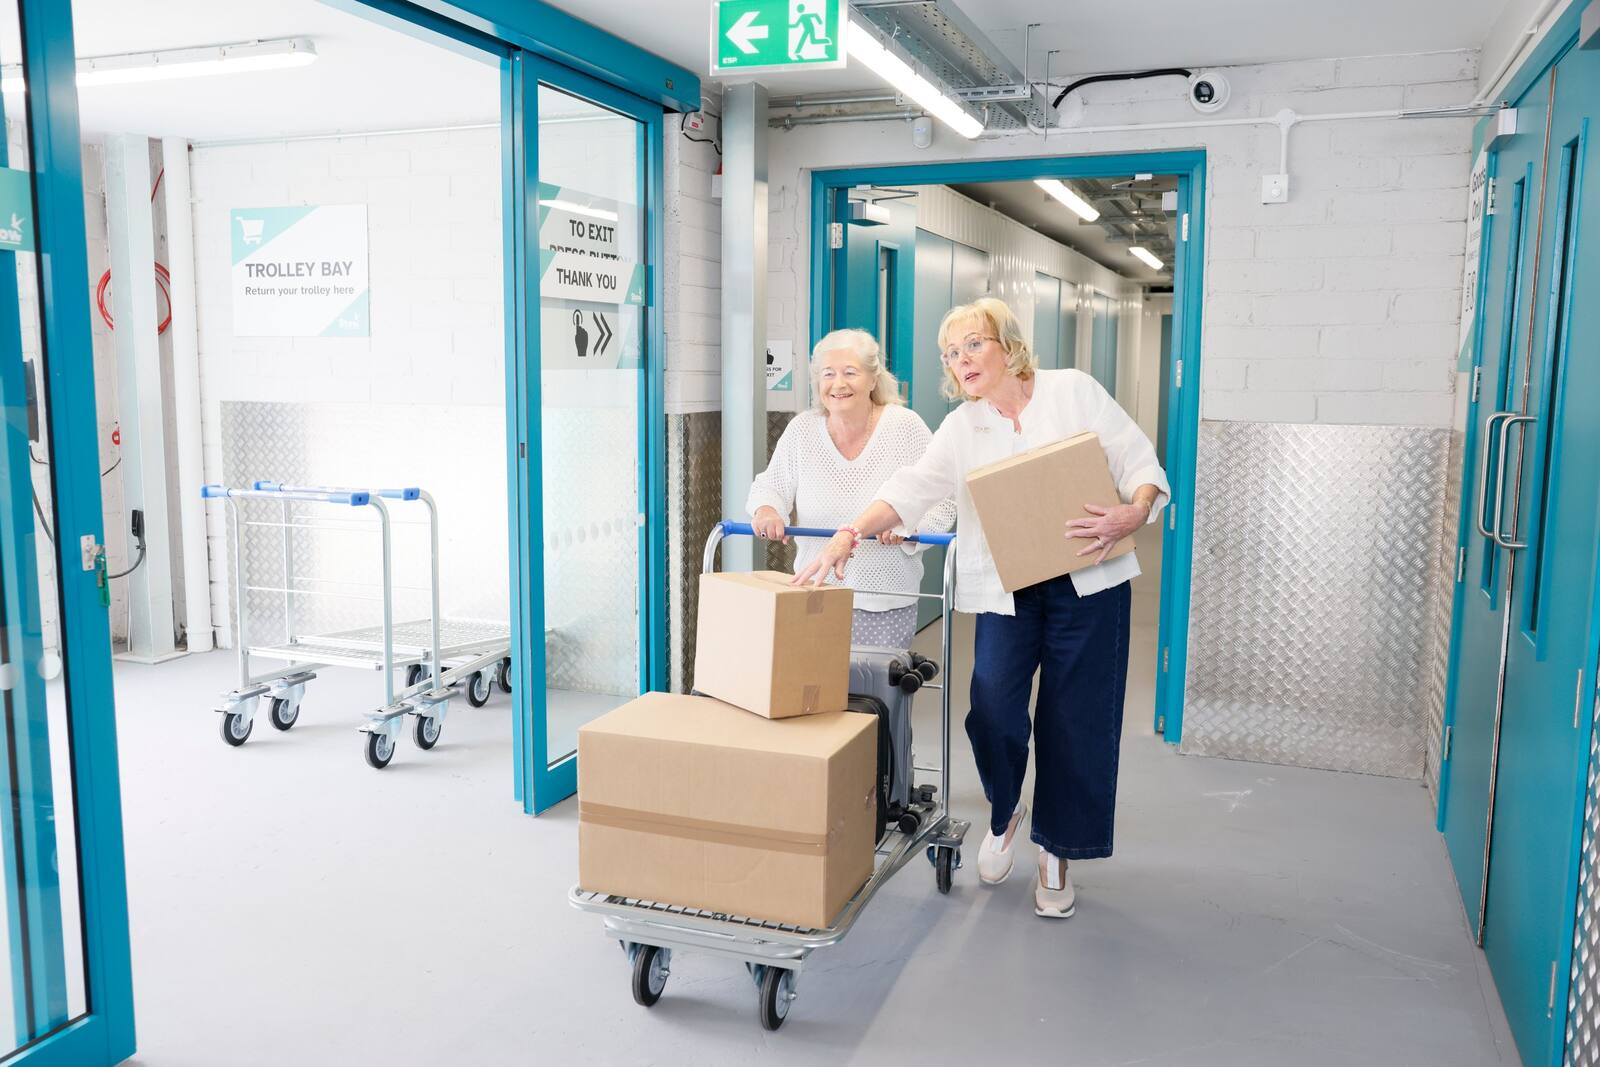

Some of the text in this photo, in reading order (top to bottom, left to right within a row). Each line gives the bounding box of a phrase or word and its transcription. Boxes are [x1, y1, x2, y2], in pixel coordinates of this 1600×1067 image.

[569, 219, 615, 243] TO EXIT
[245, 261, 353, 278] TROLLEY BAY
[556, 267, 617, 290] THANK YOU
[245, 284, 355, 297] Return your trolley here
